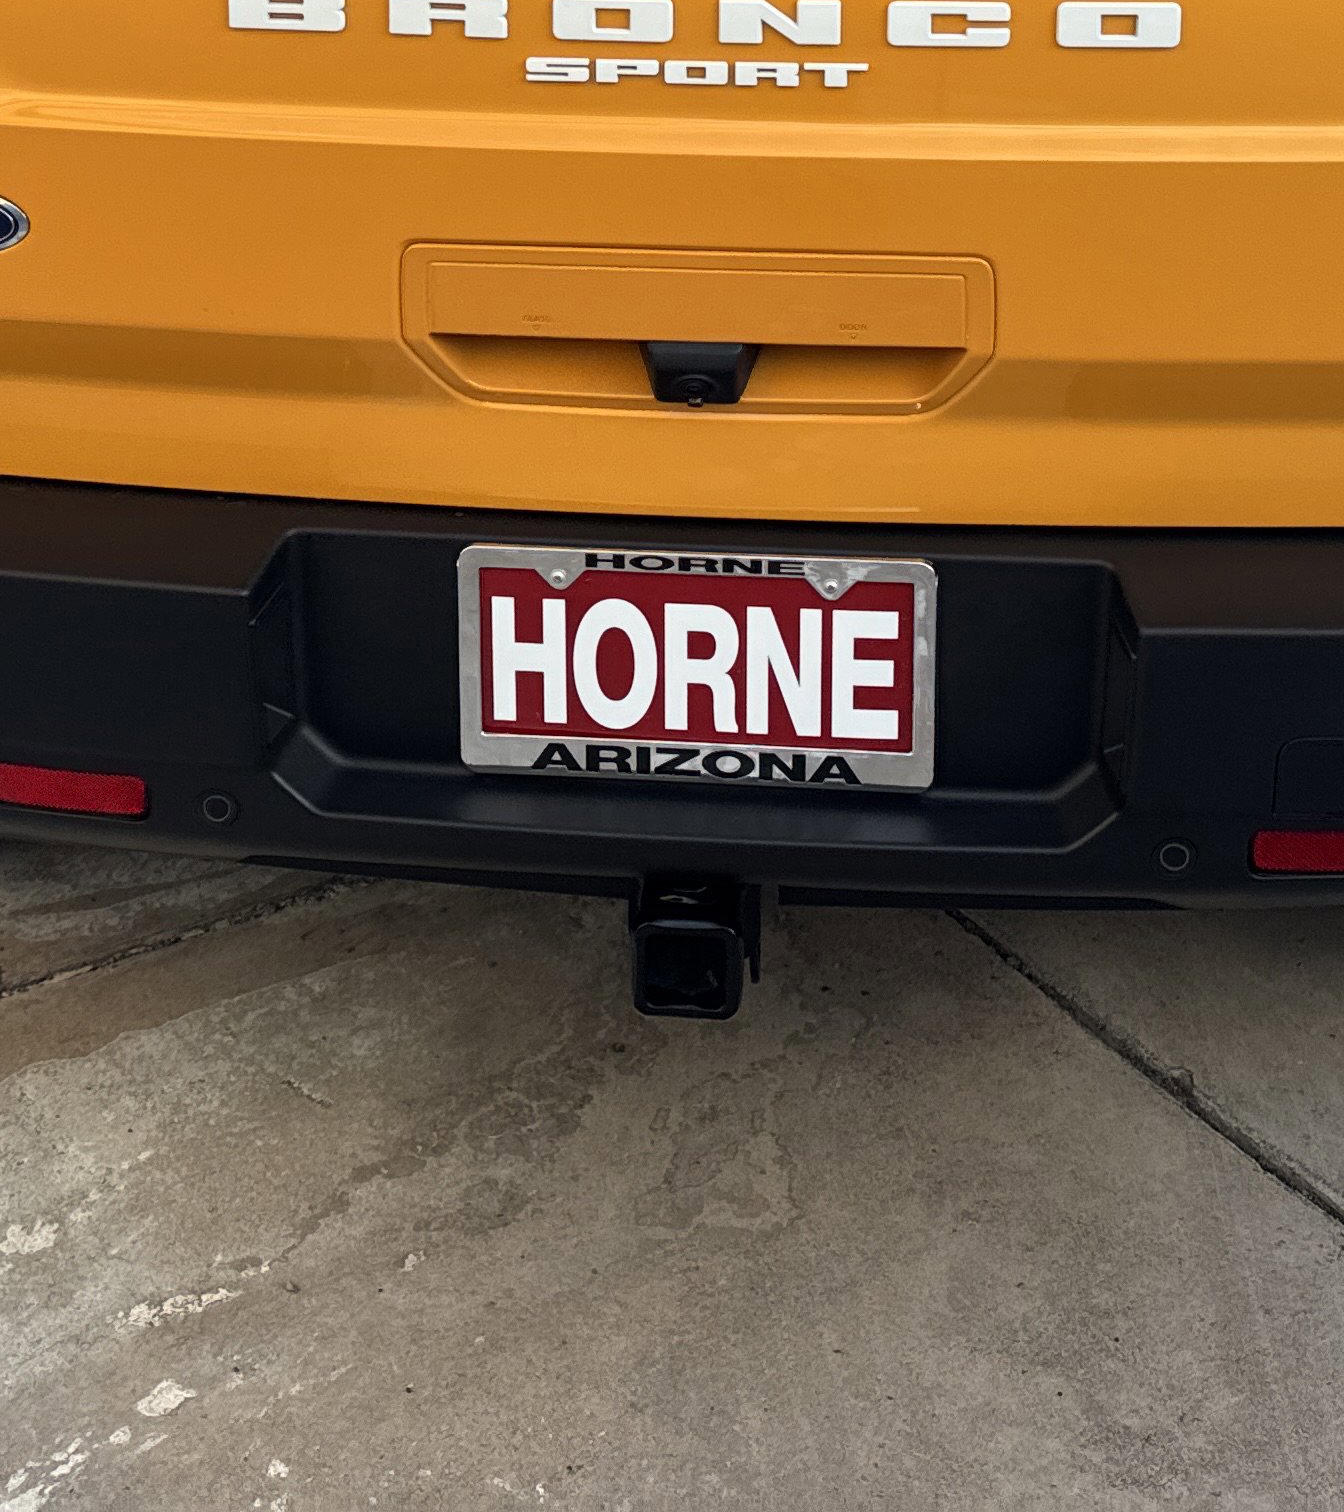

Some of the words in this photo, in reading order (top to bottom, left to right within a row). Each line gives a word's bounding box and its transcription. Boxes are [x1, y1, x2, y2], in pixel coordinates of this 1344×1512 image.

[525, 55, 870, 88] SPORT
[585, 552, 807, 577] HORNE
[490, 595, 900, 740] HORNE
[531, 742, 862, 786] ARIZONA
